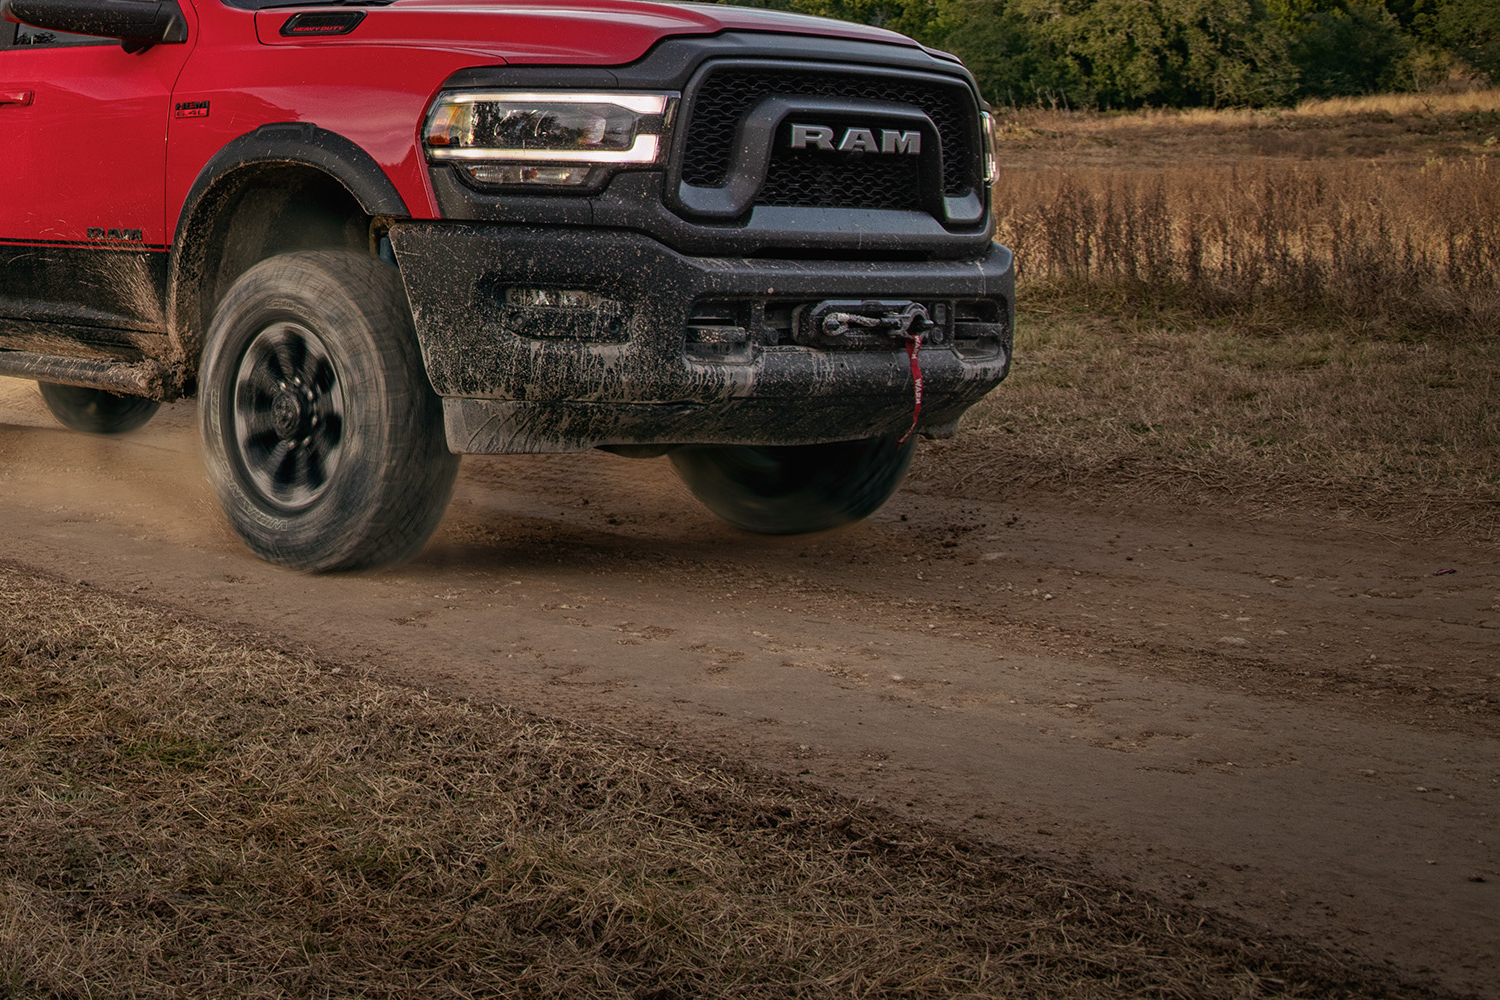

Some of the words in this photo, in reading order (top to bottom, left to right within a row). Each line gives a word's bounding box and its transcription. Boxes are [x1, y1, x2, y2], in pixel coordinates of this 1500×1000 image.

[175, 100, 210, 110] HEMI
[791, 123, 921, 155] RAM
[87, 227, 143, 241] RAM
[914, 378, 923, 404] WARN
